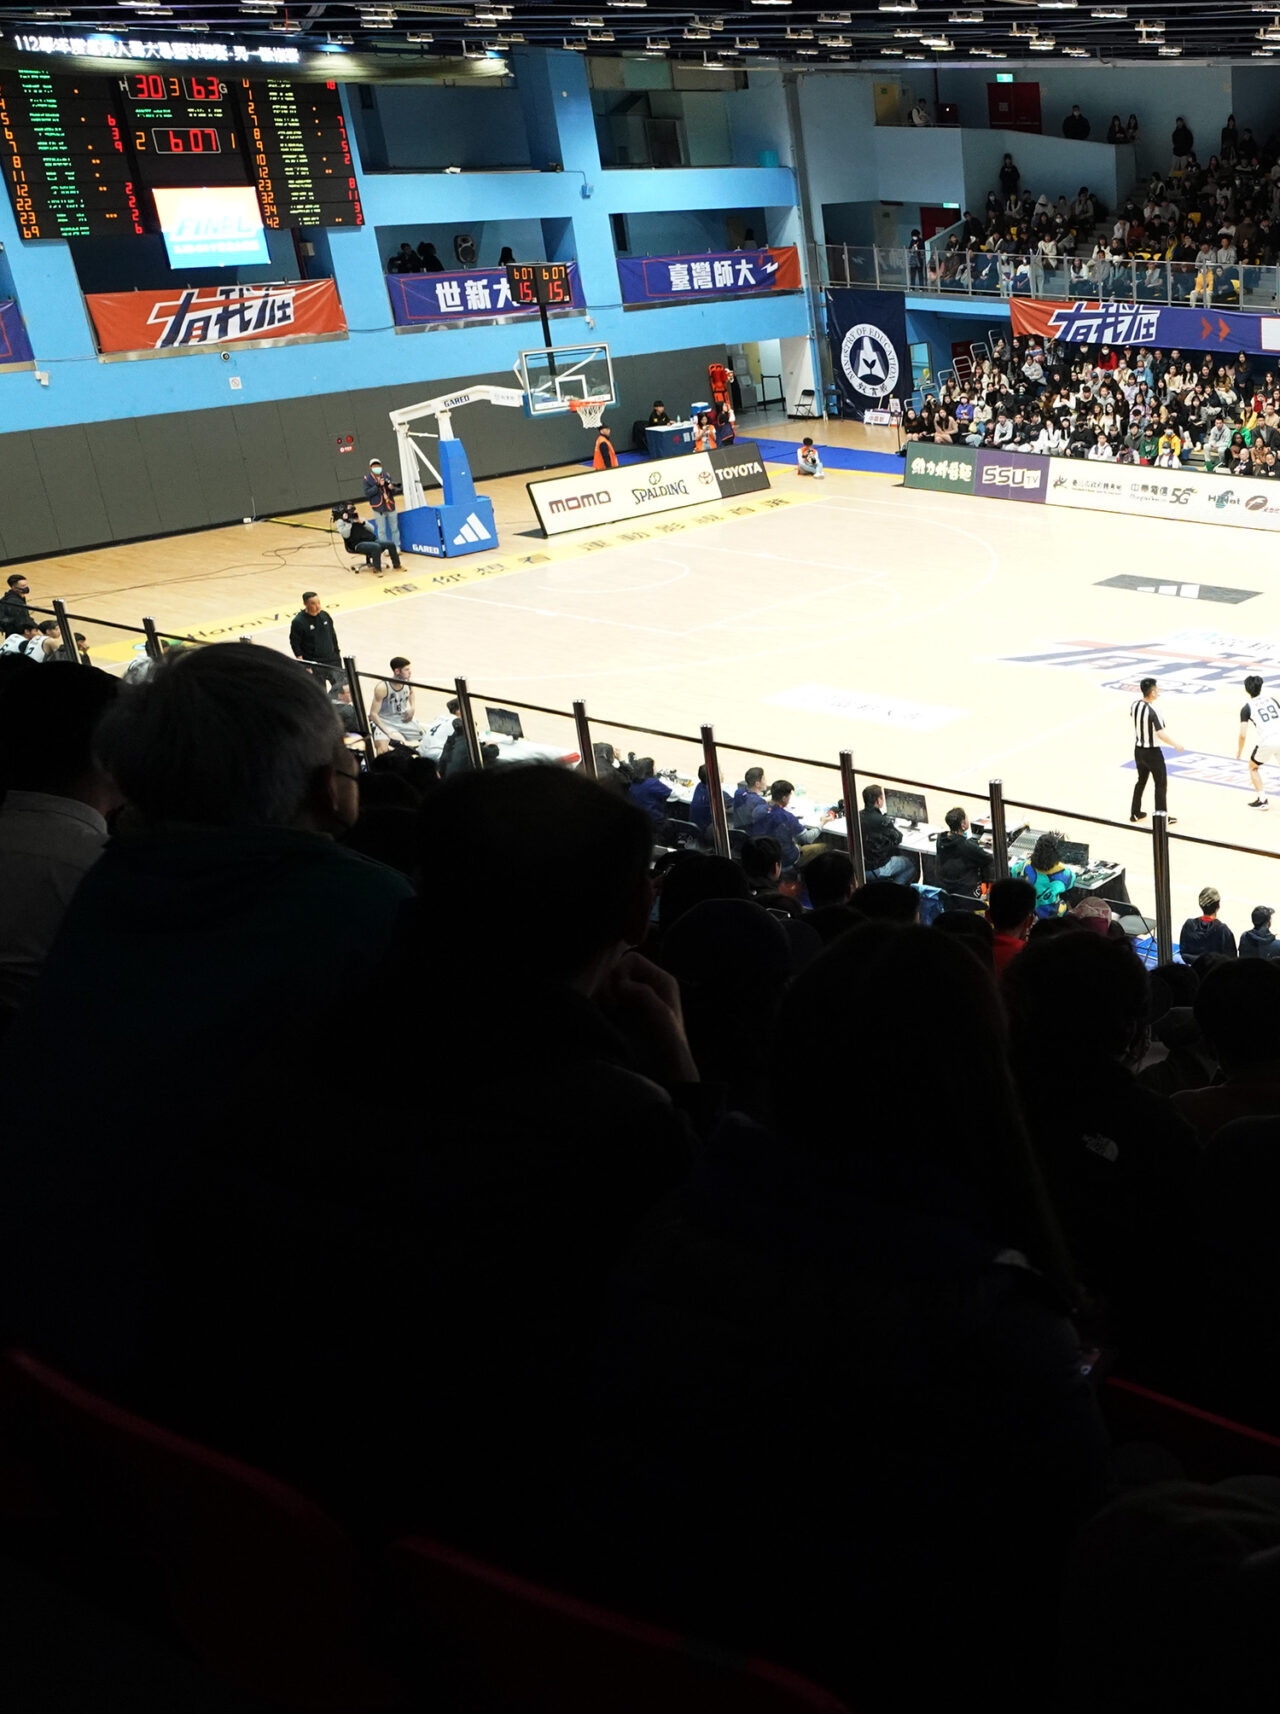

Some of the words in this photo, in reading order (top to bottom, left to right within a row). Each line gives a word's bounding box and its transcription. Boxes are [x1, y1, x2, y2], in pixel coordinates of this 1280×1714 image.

[135, 75, 163, 98] 30
[169, 78, 180, 96] 3
[191, 77, 219, 99] 63
[248, 102, 255, 114] 2
[0, 112, 10, 125] 5
[251, 115, 258, 126] 7
[5, 127, 13, 139] 6
[253, 128, 261, 140] 8
[135, 131, 146, 150] 2
[256, 141, 264, 152] 9
[9, 141, 17, 153] 7
[12, 155, 21, 168] 8
[256, 153, 266, 165] 10
[13, 170, 25, 182] 11
[259, 167, 269, 178] 12
[16, 184, 28, 196] 12
[258, 179, 272, 191] 23
[261, 192, 274, 203] 32
[16, 198, 32, 210] 22
[264, 205, 277, 217] 34
[20, 212, 36, 224] 23
[266, 217, 280, 229] 42
[23, 226, 40, 239] 69
[668, 259, 756, 291] 臺灣師大
[519, 281, 532, 301] 15
[548, 281, 563, 301] 15
[444, 394, 470, 407] GARED
[631, 480, 690, 505] SPALDING
[715, 461, 763, 481] TOYOTA
[412, 543, 440, 555] GARED
[1257, 704, 1279, 723] 69
